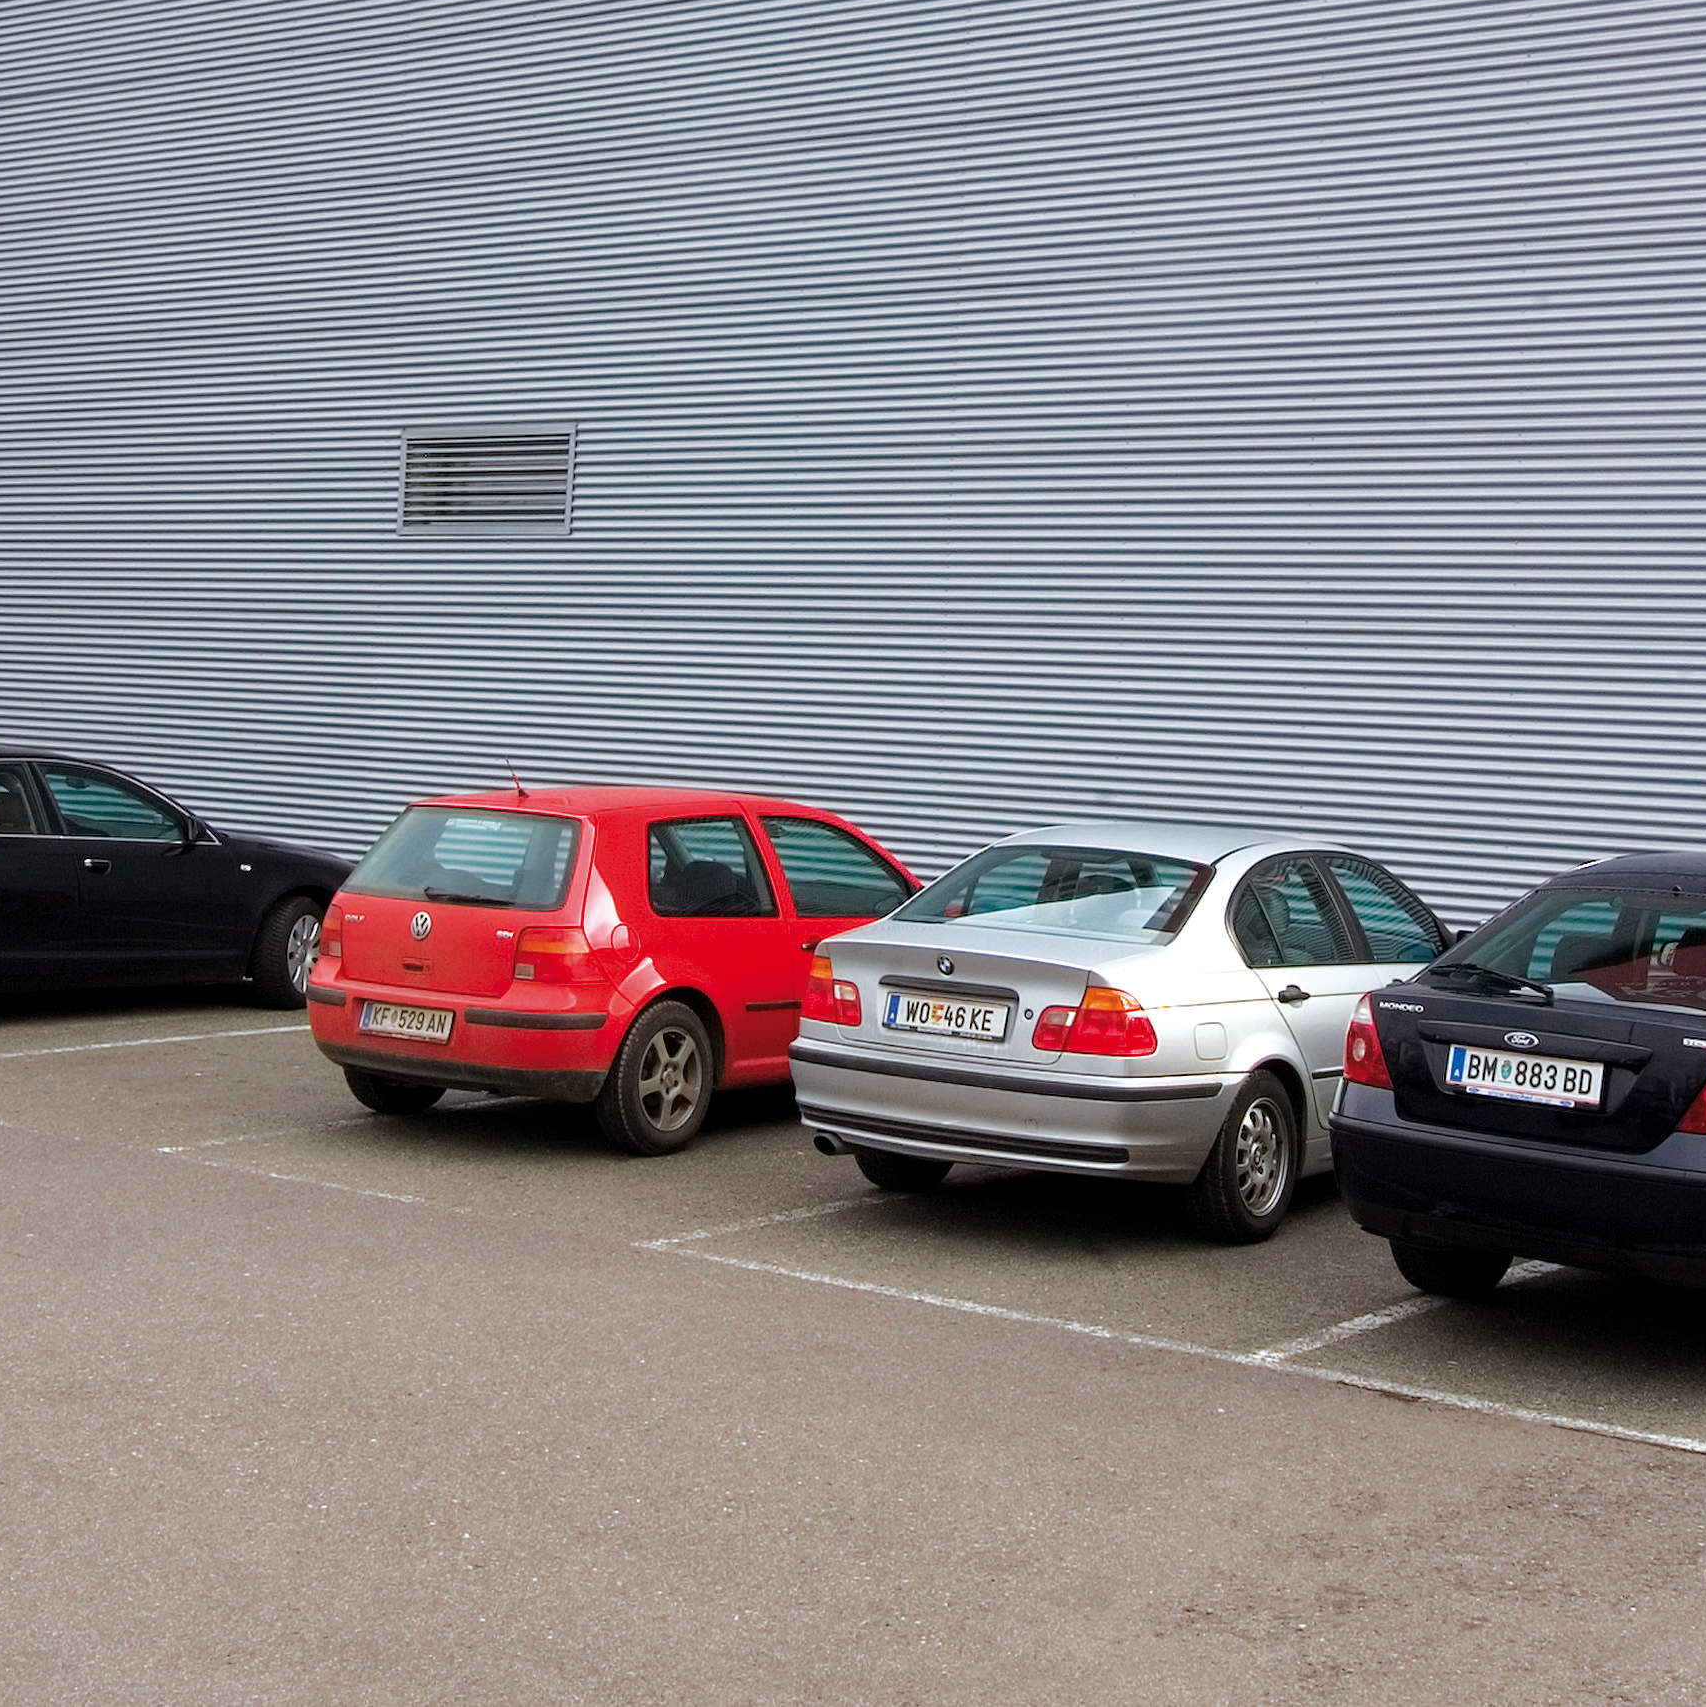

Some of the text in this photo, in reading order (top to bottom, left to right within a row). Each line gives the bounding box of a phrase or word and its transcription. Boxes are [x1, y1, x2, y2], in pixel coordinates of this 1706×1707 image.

[371, 1005, 447, 1034] KF 529 AN
[906, 1000, 994, 1032] WO 46 KE
[1379, 1001, 1424, 1013] MONDEO
[1467, 1053, 1593, 1094] BM 883 BD
